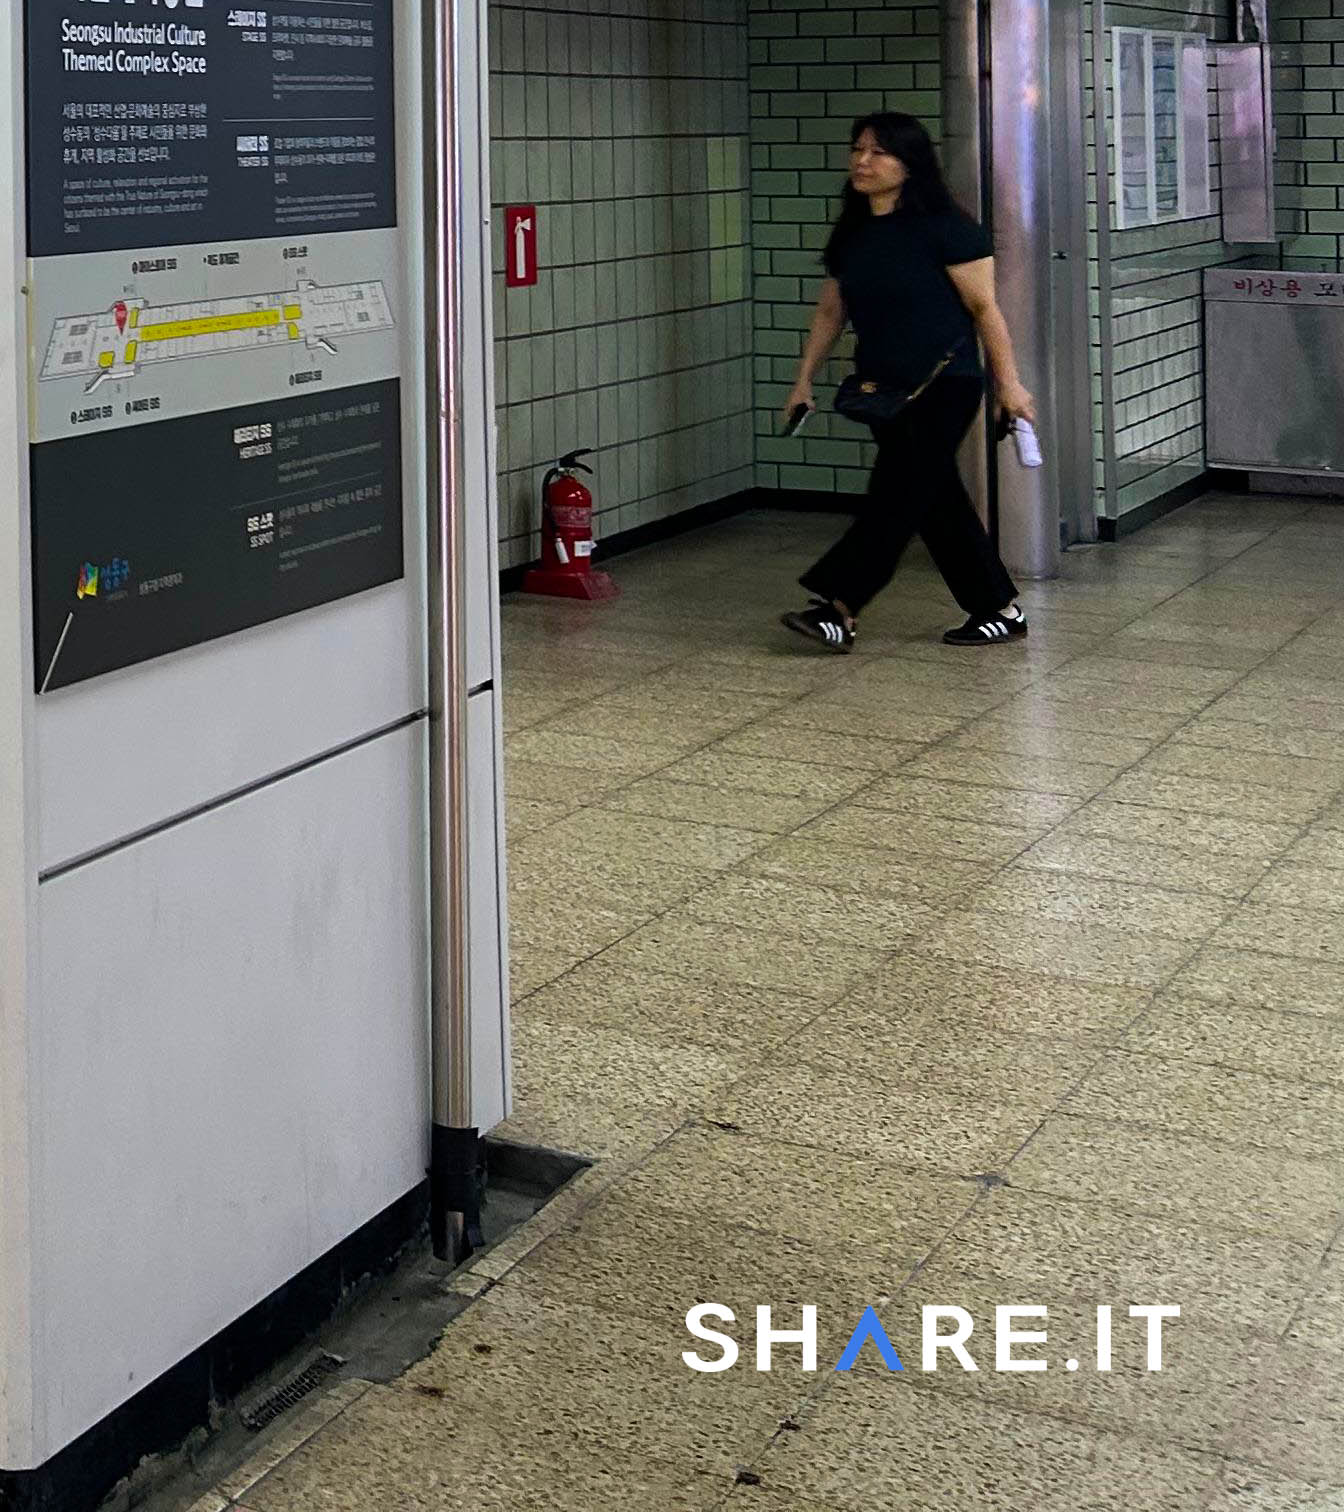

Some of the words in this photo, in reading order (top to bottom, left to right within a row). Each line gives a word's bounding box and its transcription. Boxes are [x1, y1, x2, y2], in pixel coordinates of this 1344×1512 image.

[62, 18, 112, 46] Seongsu
[114, 21, 165, 45] Industrial
[167, 23, 206, 46] Culture
[62, 49, 113, 72] Themed
[115, 50, 170, 75] Complex
[172, 51, 206, 76] Space
